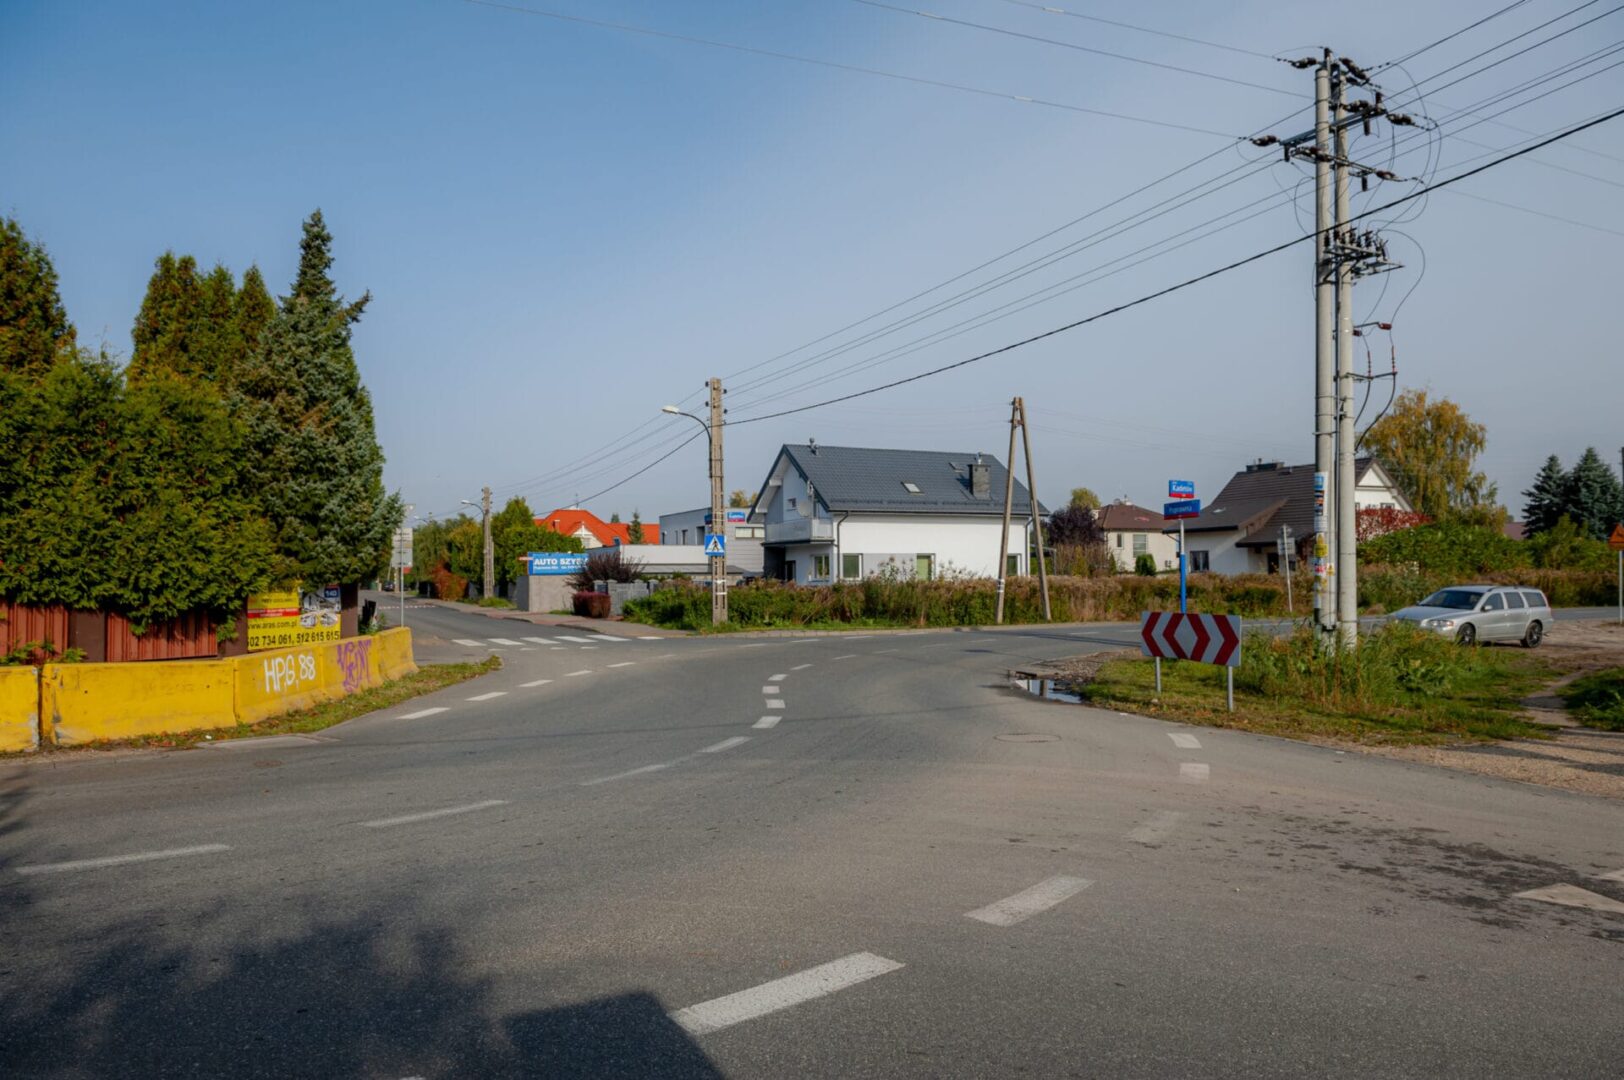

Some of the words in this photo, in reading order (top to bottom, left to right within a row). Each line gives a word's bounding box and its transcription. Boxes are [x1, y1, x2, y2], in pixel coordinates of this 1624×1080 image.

[262, 635, 276, 646] 734
[296, 632, 310, 643] 512
[311, 631, 324, 642] 615
[326, 630, 340, 640] 615
[298, 654, 316, 680] 88
